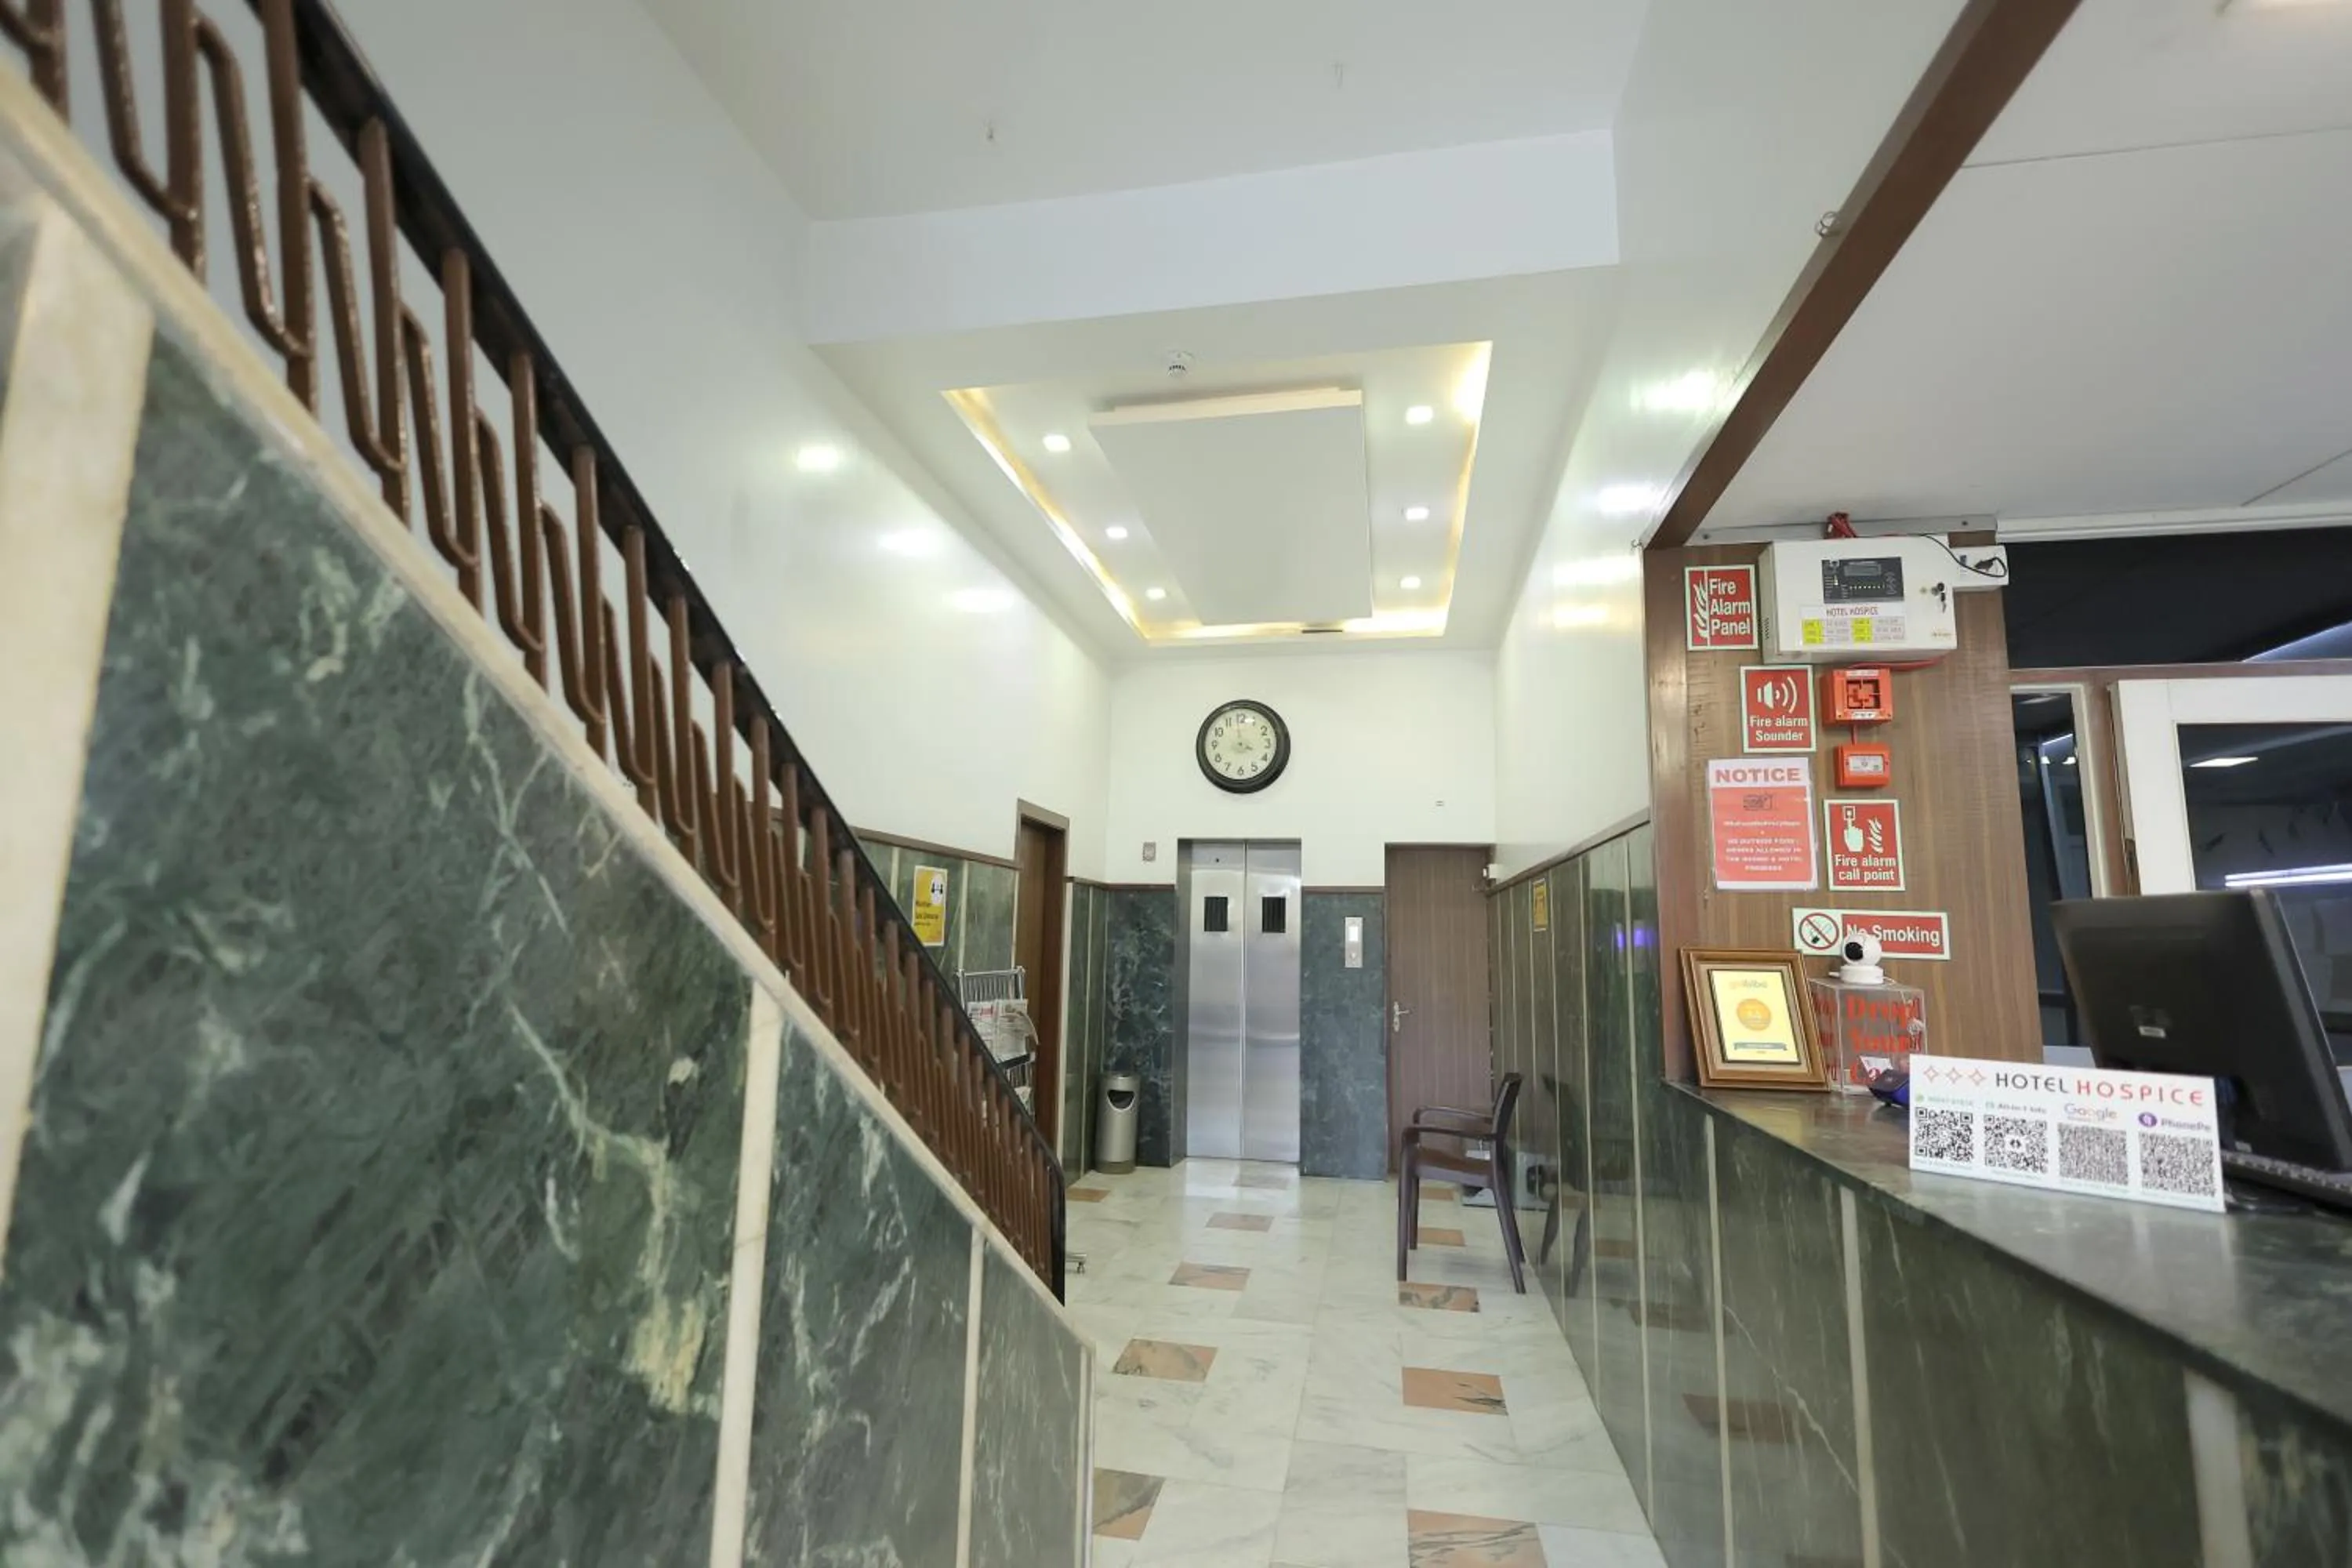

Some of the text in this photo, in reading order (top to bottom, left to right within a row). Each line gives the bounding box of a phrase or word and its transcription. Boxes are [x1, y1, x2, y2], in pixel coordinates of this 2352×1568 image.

[1709, 578, 1737, 595] Fire
[1710, 598, 1751, 615] Alarm
[1711, 617, 1751, 637] Panel
[1225, 717, 1232, 728] 11
[1236, 713, 1246, 724] 12
[1749, 714, 1808, 728] Fire alarm
[1214, 727, 1224, 738] 10
[1261, 725, 1268, 736] 2
[1755, 729, 1804, 742] Sounder
[1211, 740, 1218, 750] 9
[1264, 738, 1272, 750] 3
[1225, 762, 1231, 771] 7
[1237, 765, 1244, 776] 6
[1250, 762, 1258, 772] 5
[1715, 768, 1801, 783] NOTICE
[1835, 854, 1896, 866] Fire alarm
[1838, 868, 1895, 884] call point
[1871, 924, 1940, 947] Smoking
[1846, 994, 1907, 1029] Drop
[1995, 1072, 2204, 1106] HOTEL HOSPICE
[2063, 1102, 2117, 1120] Google
[2161, 1118, 2212, 1131] PhonePe
